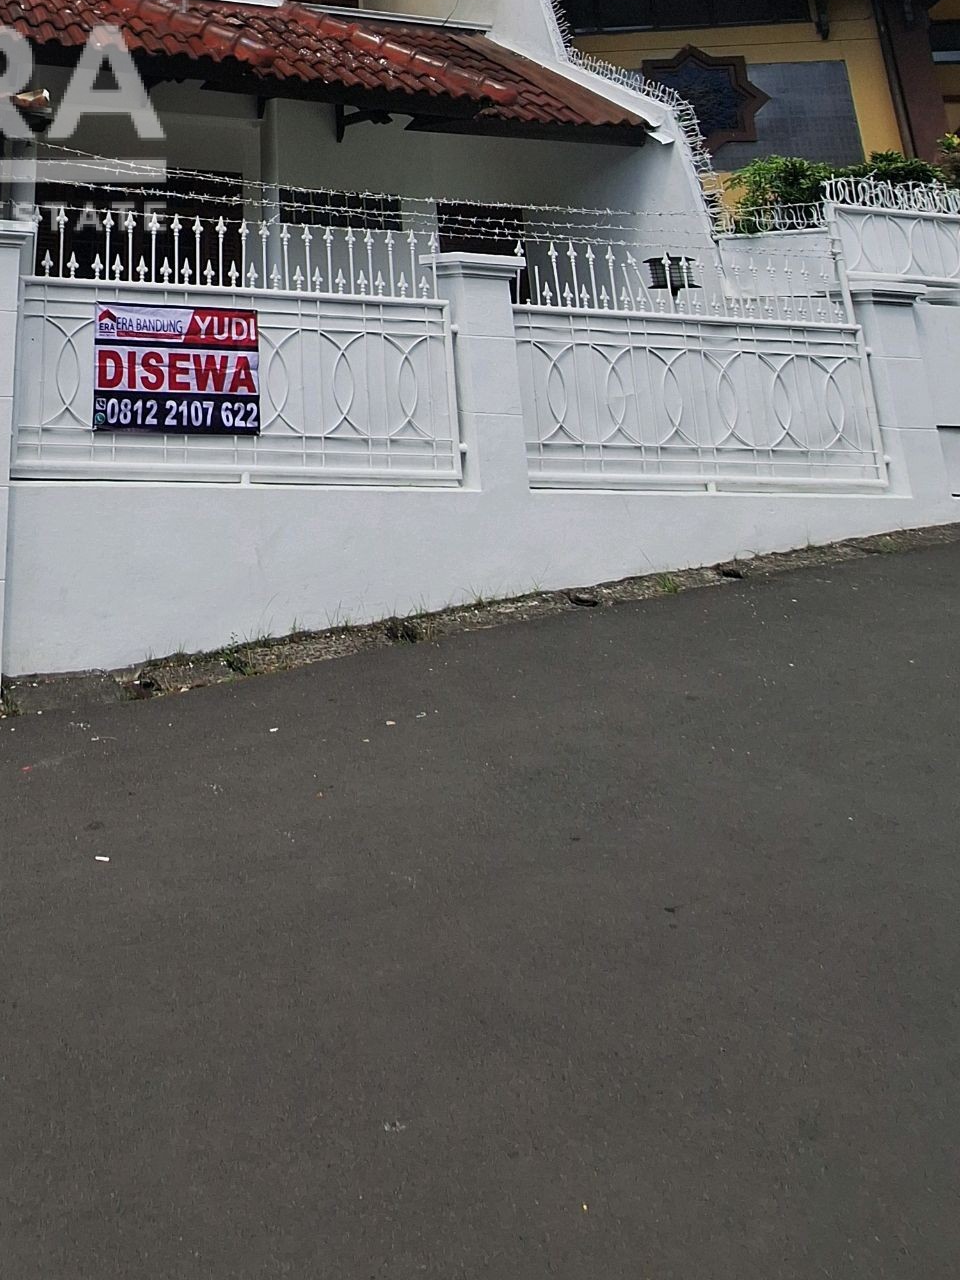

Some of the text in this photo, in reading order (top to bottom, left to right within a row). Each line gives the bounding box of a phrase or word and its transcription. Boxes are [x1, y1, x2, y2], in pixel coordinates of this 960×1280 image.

[98, 322, 116, 331] ERA
[116, 317, 183, 334] ERA BANDUNG
[194, 316, 256, 341] YUDI
[98, 350, 257, 393] DISEWA
[106, 398, 259, 428] 0812 2107 622
